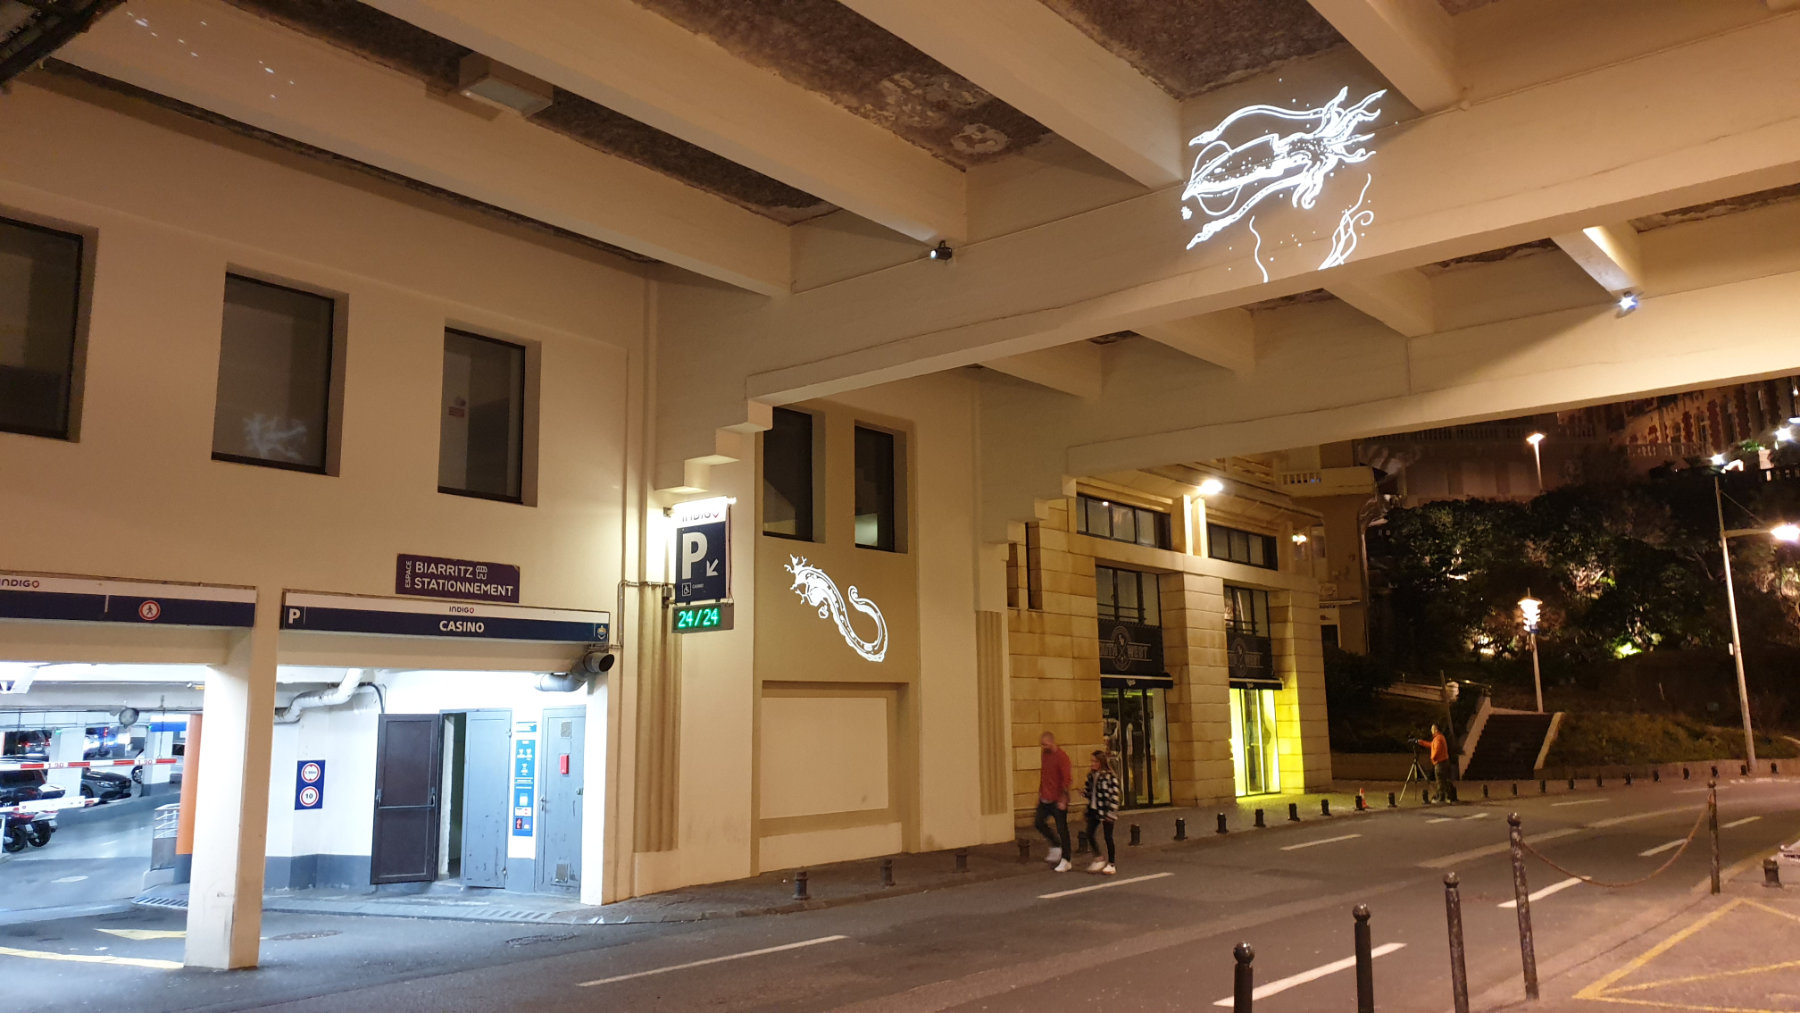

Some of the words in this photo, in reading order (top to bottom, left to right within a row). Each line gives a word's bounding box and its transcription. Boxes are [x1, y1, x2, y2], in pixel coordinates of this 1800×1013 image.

[682, 531, 708, 580] P
[404, 560, 413, 588] ESPACE
[415, 561, 473, 578] BIARRITZ
[0, 578, 40, 588] NDIGO
[414, 577, 514, 597] STATIONNEMENT
[288, 608, 300, 624] P
[449, 605, 475, 614] INDIGO
[678, 608, 718, 628] 24/24
[439, 620, 485, 633] CASINO
